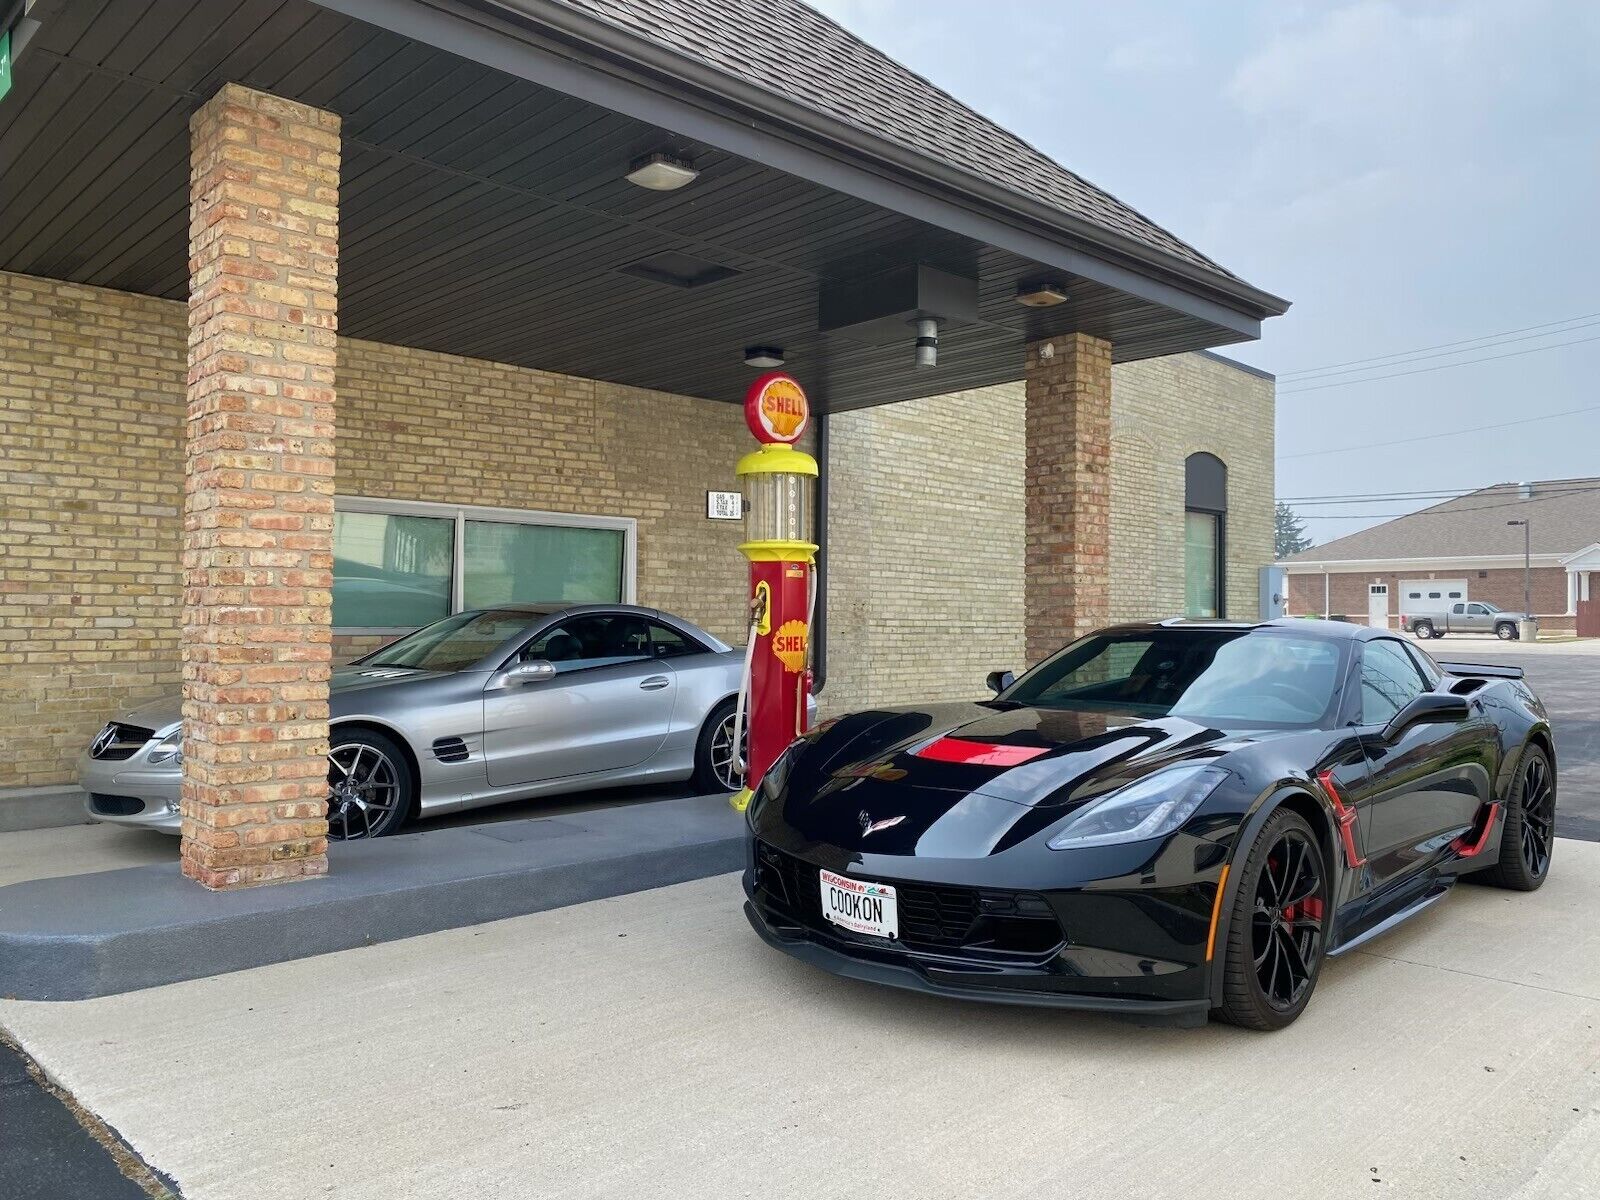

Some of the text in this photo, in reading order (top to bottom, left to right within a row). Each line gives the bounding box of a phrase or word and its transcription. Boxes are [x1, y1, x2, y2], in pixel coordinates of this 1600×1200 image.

[766, 396, 803, 417] SHELL
[777, 636, 805, 652] SHEL
[830, 886, 883, 923] COOKON
